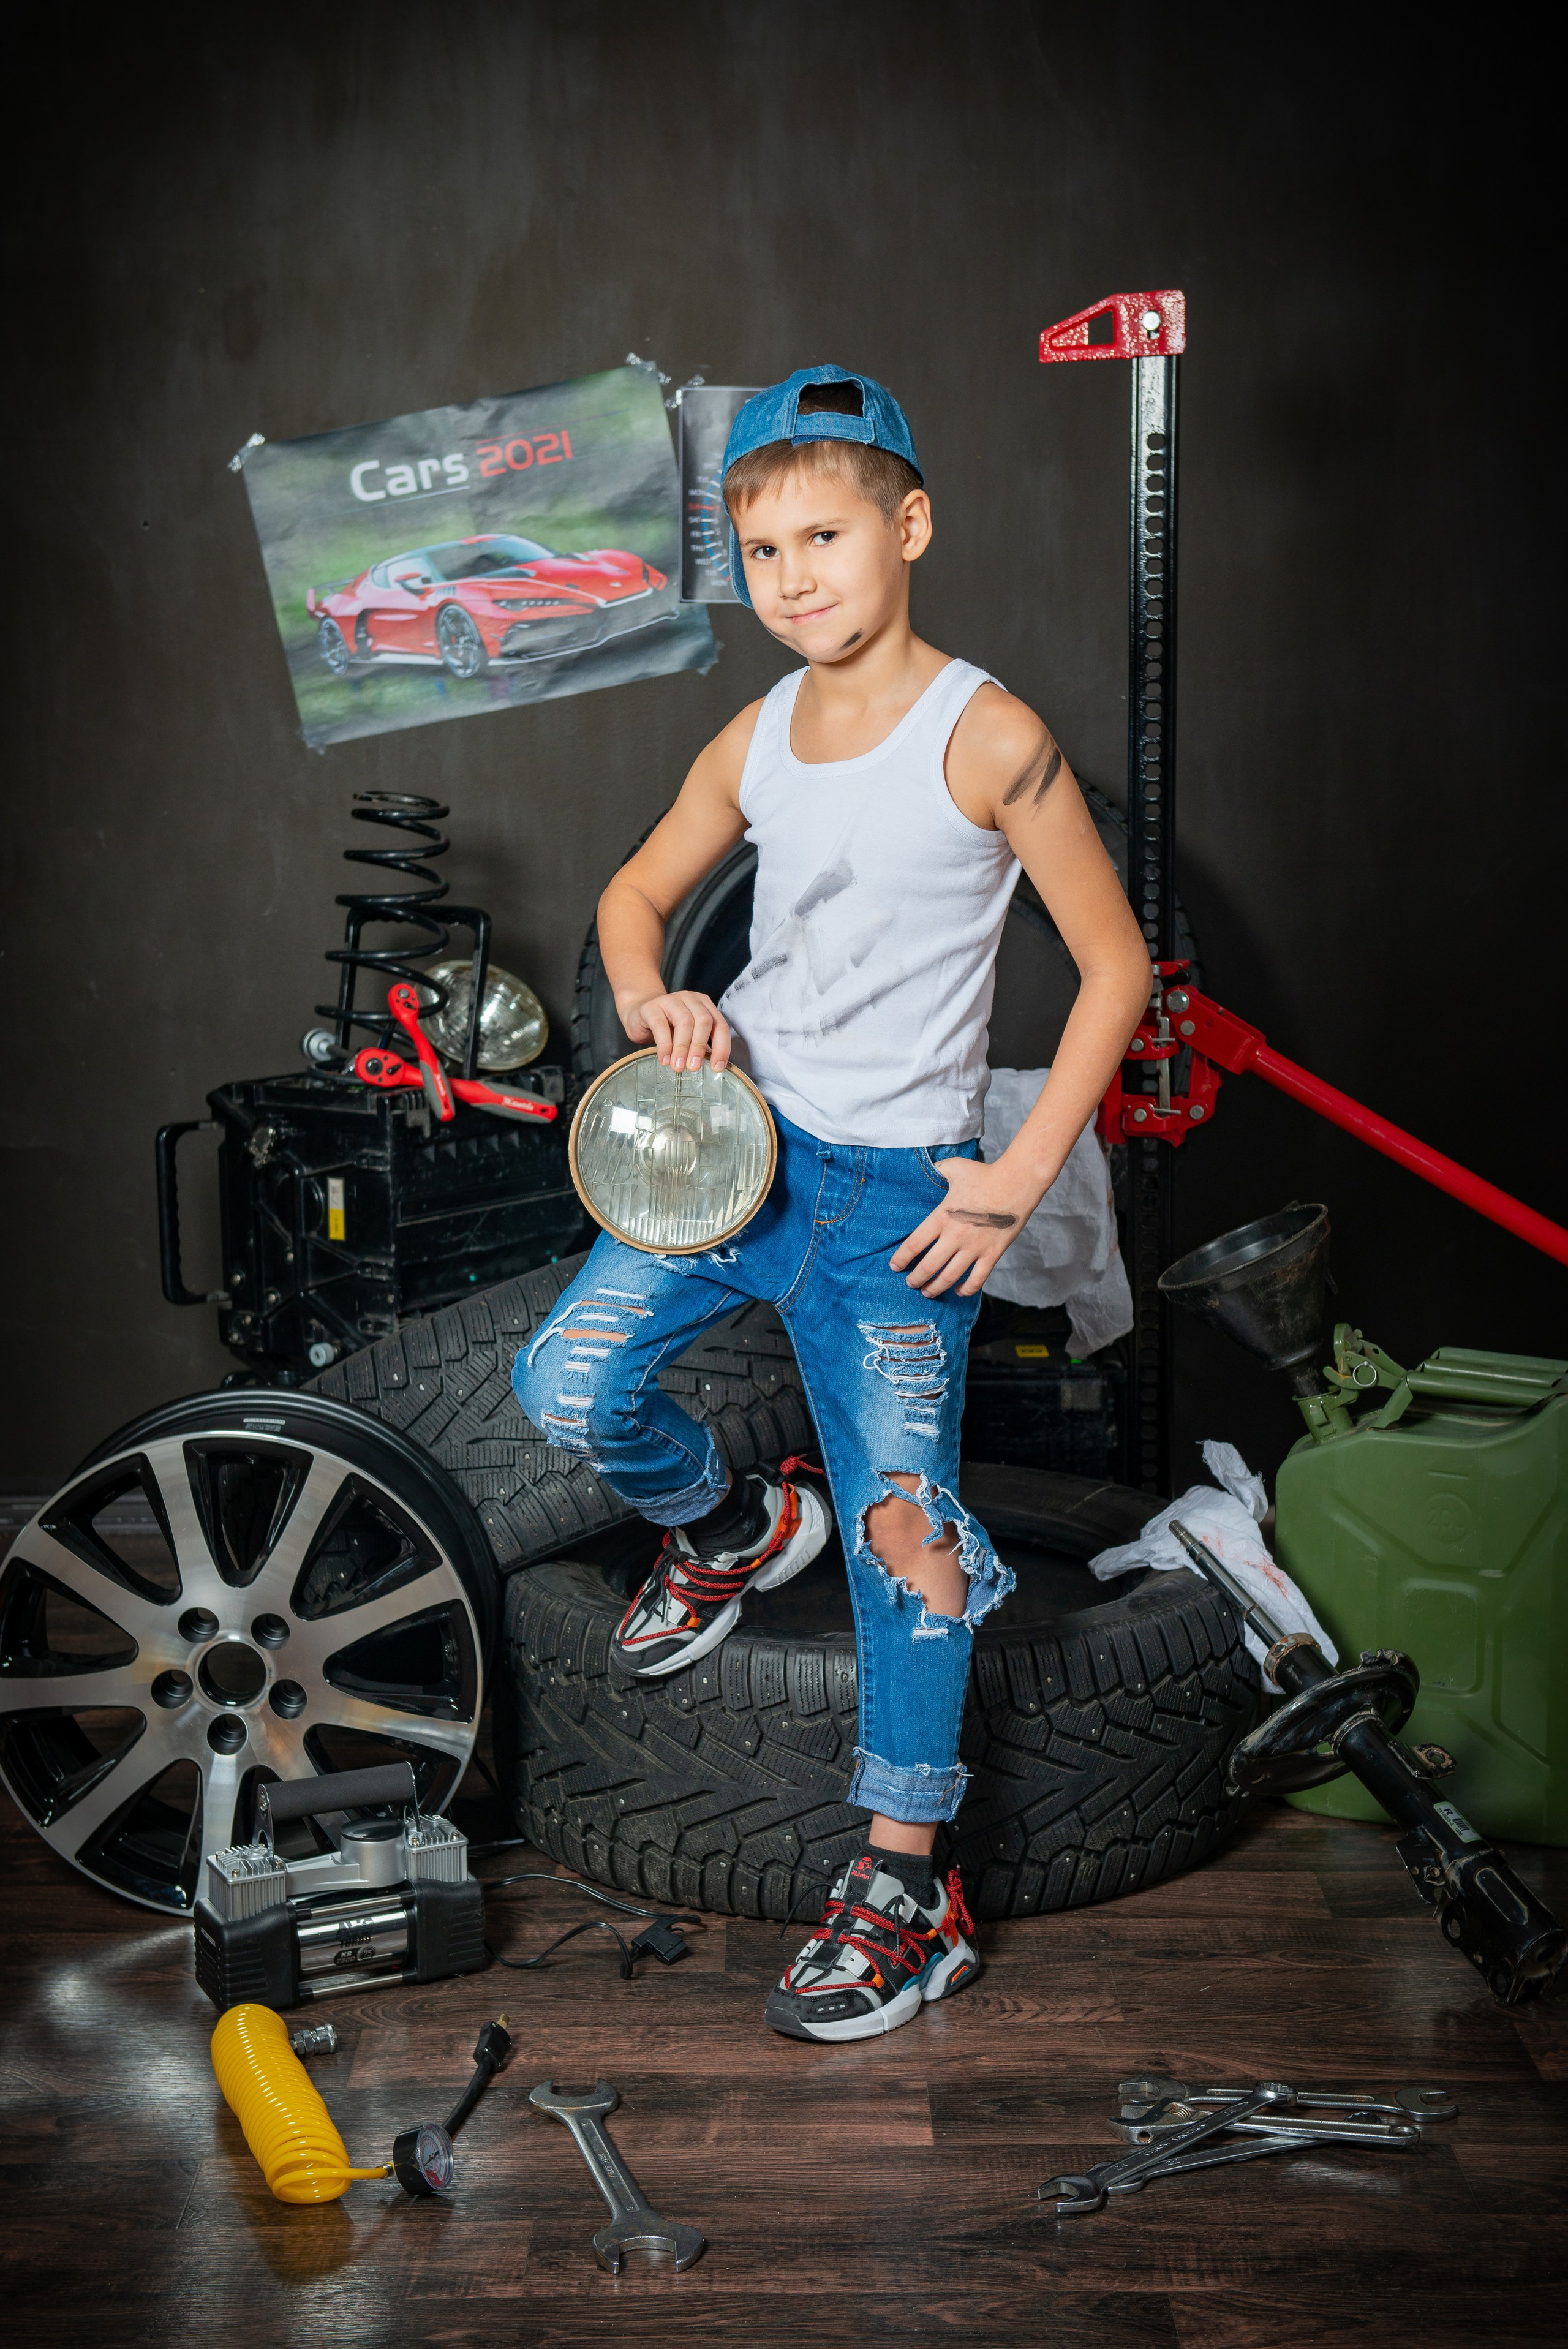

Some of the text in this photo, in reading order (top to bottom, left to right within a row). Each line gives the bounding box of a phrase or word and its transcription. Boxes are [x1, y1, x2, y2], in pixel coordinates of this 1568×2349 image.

[350, 430, 573, 502] Cars 2021
[1113, 2163, 1128, 2171] 24
